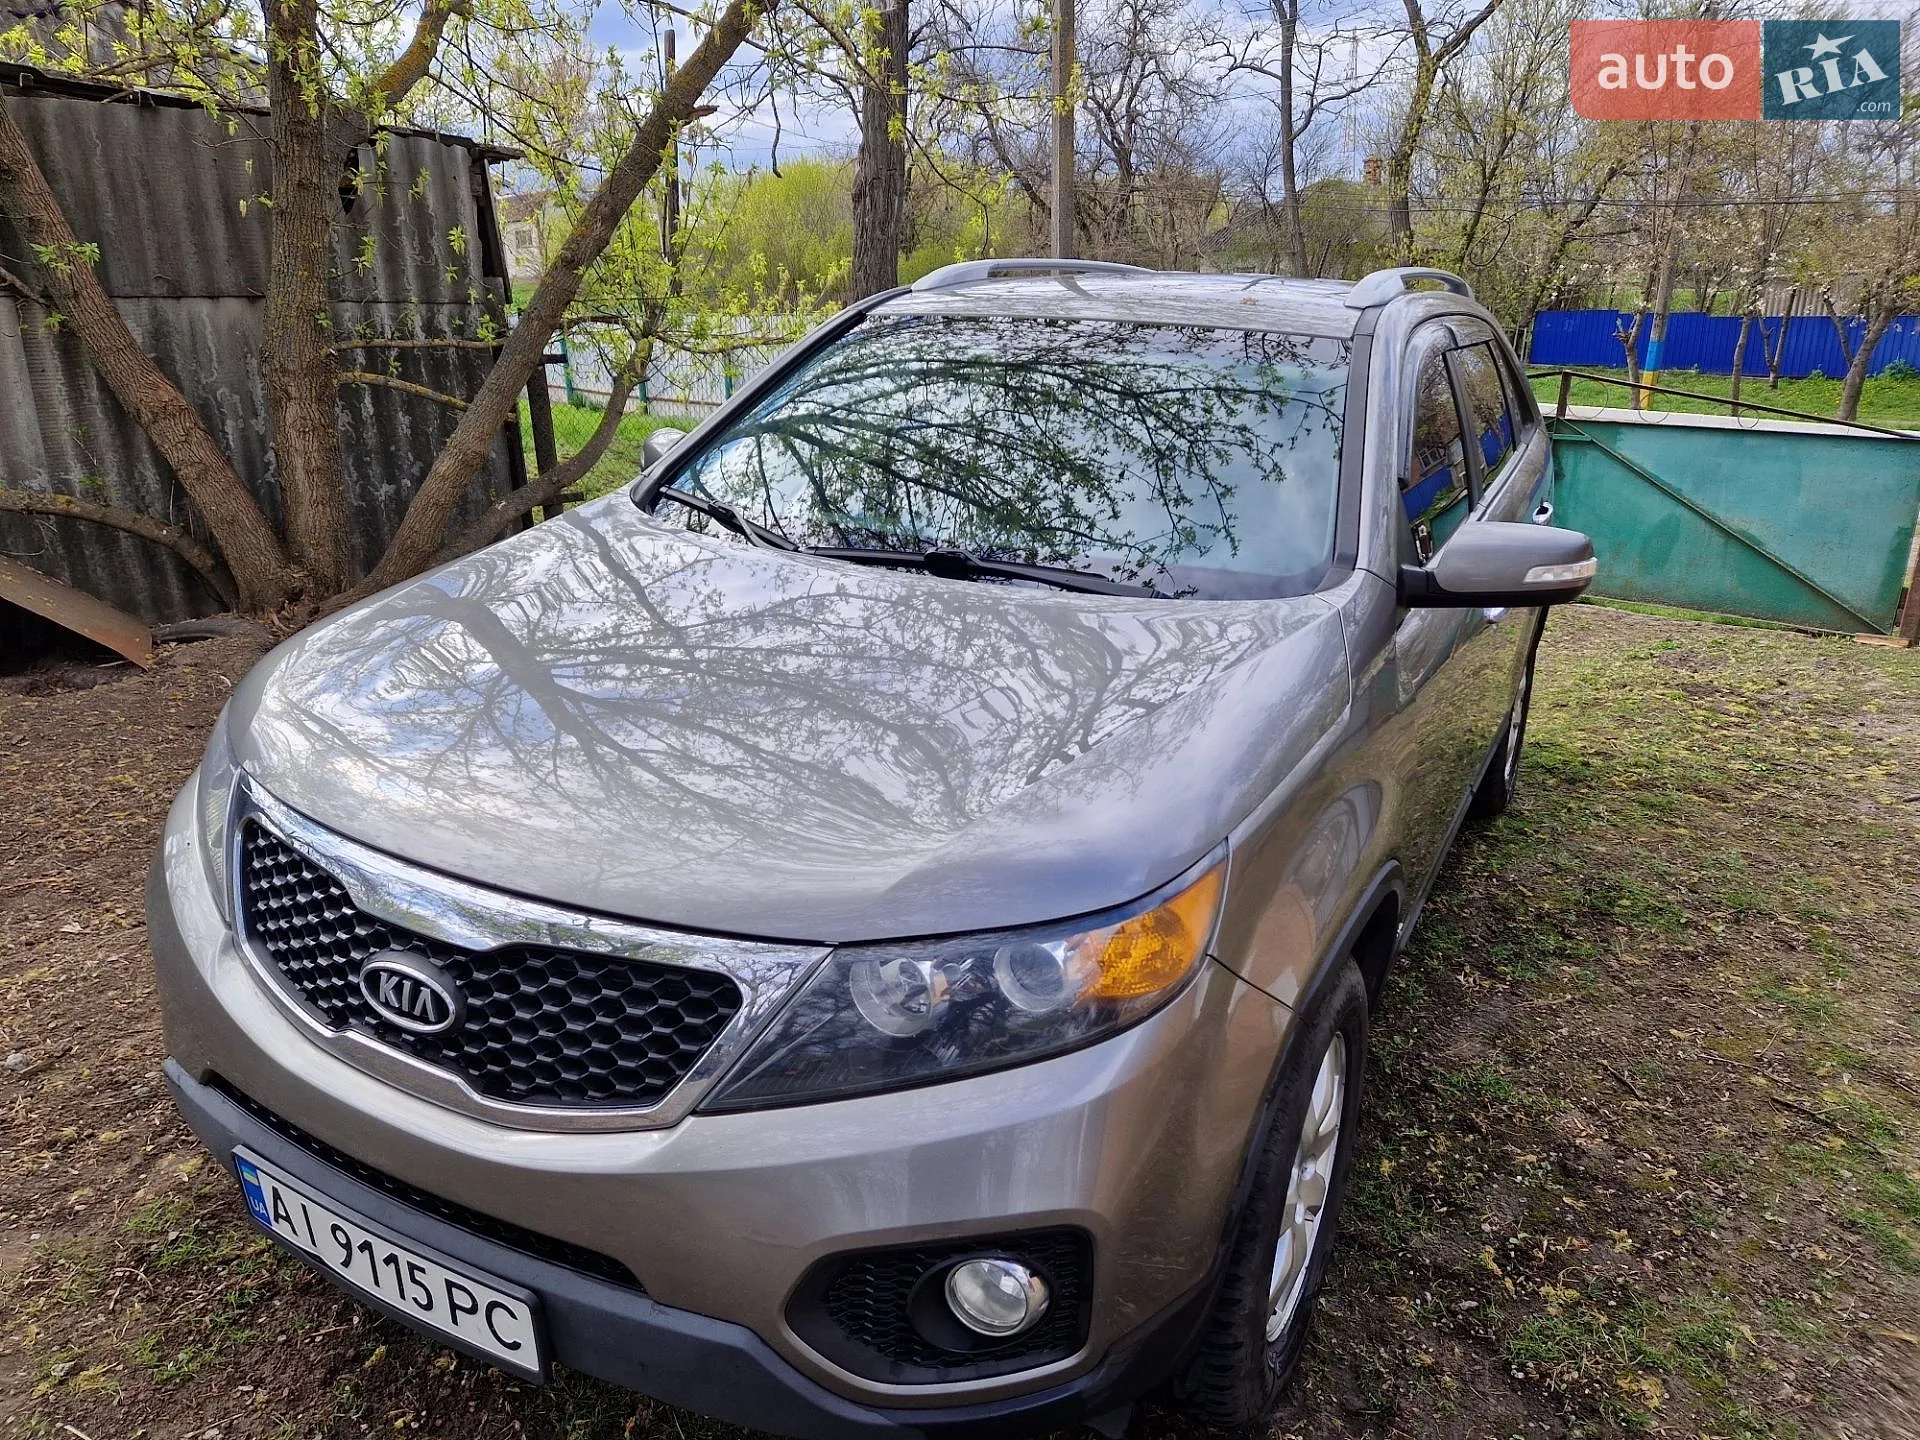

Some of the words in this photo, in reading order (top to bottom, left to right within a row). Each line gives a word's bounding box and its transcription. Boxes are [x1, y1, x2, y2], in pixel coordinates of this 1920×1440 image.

[380, 971, 435, 1022] KIA
[250, 1196, 268, 1217] UA
[271, 1186, 317, 1248] AI
[330, 1223, 434, 1312] 9115
[444, 1278, 522, 1351] PC
